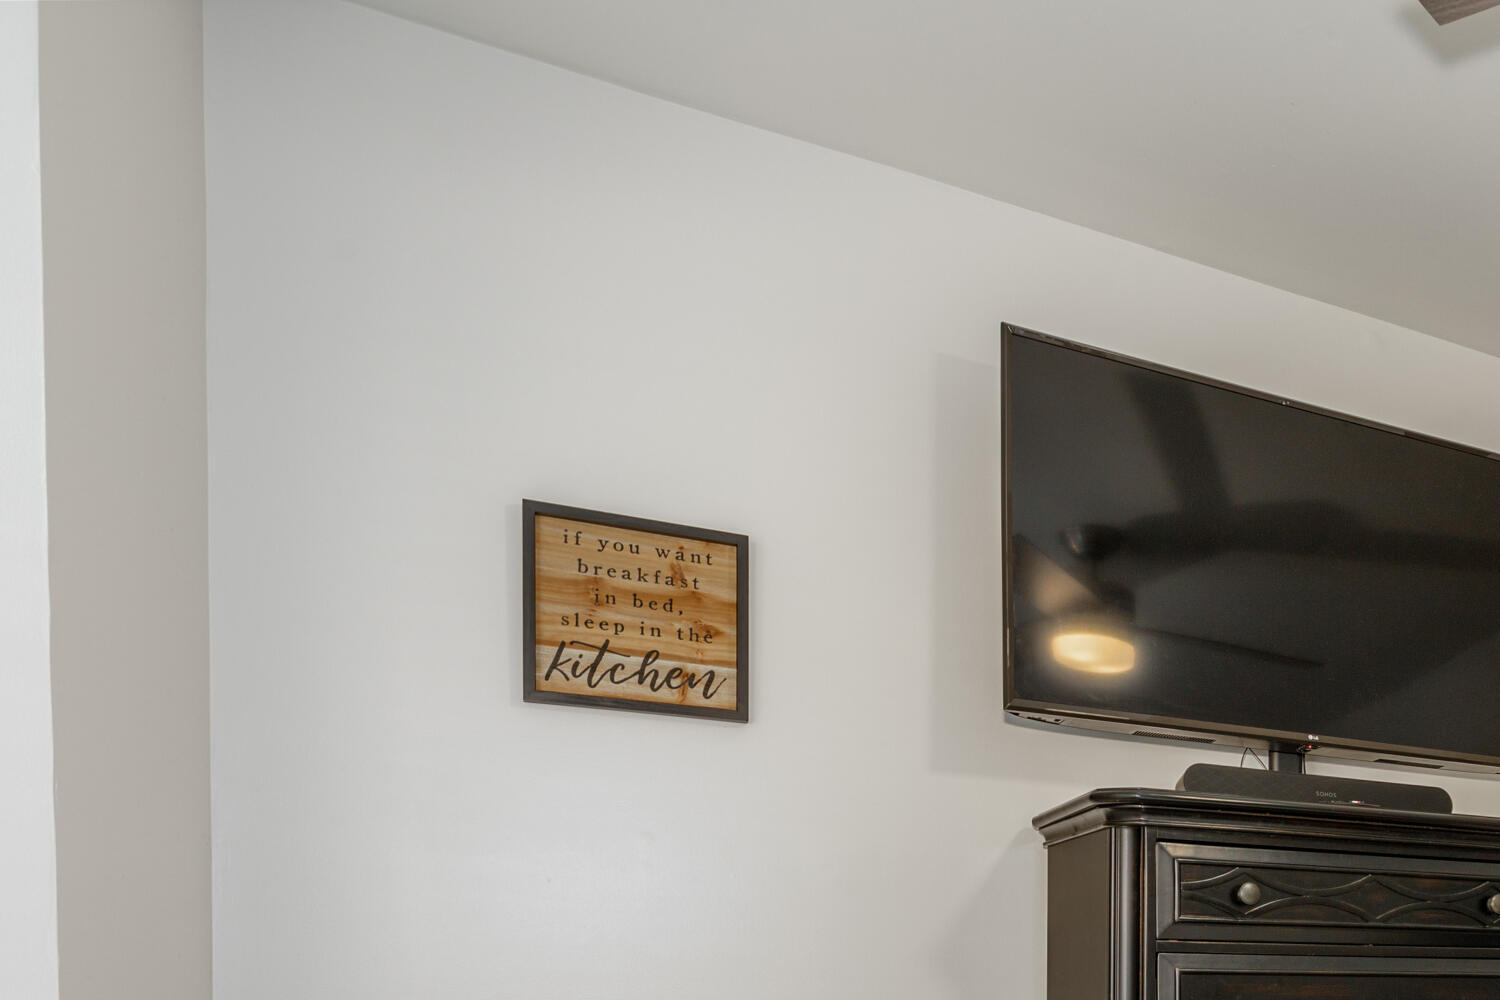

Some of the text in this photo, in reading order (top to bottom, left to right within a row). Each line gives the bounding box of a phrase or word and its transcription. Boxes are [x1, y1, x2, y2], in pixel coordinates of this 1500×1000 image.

[563, 529, 712, 566] if you want
[577, 558, 700, 590] breakfast
[594, 588, 684, 616] in bed,
[561, 613, 713, 645] sleep in the
[545, 639, 727, 700] kitchen
